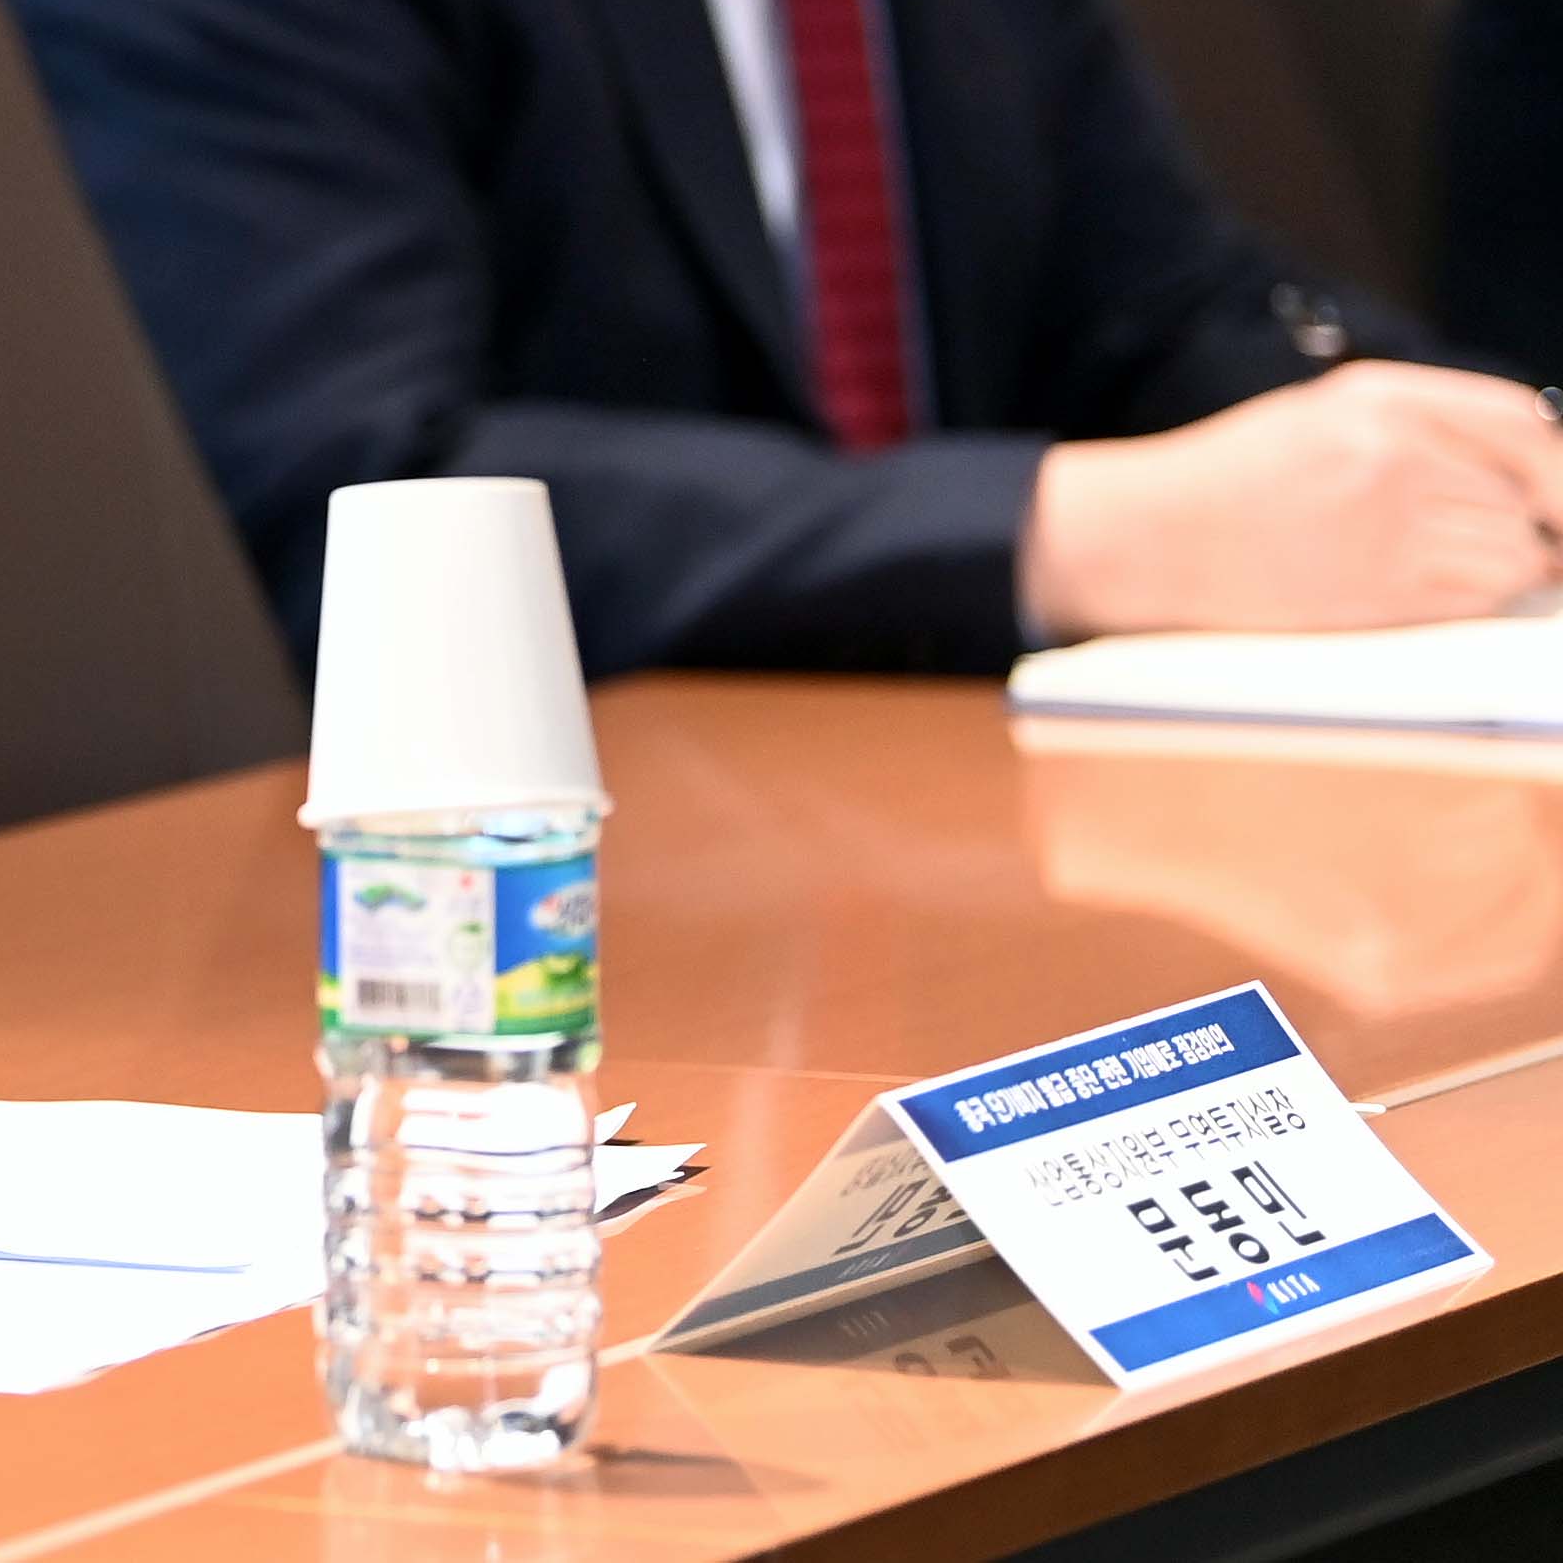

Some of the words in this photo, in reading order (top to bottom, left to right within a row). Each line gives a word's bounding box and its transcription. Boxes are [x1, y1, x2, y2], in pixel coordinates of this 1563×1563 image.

[954, 1095, 997, 1133] 중국
[1064, 1062, 1105, 1099] 중단
[1091, 1055, 1132, 1090] 관련
[1171, 1023, 1235, 1065] 점검회의
[1025, 1128, 1179, 1206] 산업통상자원부
[1169, 1087, 1306, 1160] 무역투자실장
[1126, 1160, 1326, 1281] 문동민
